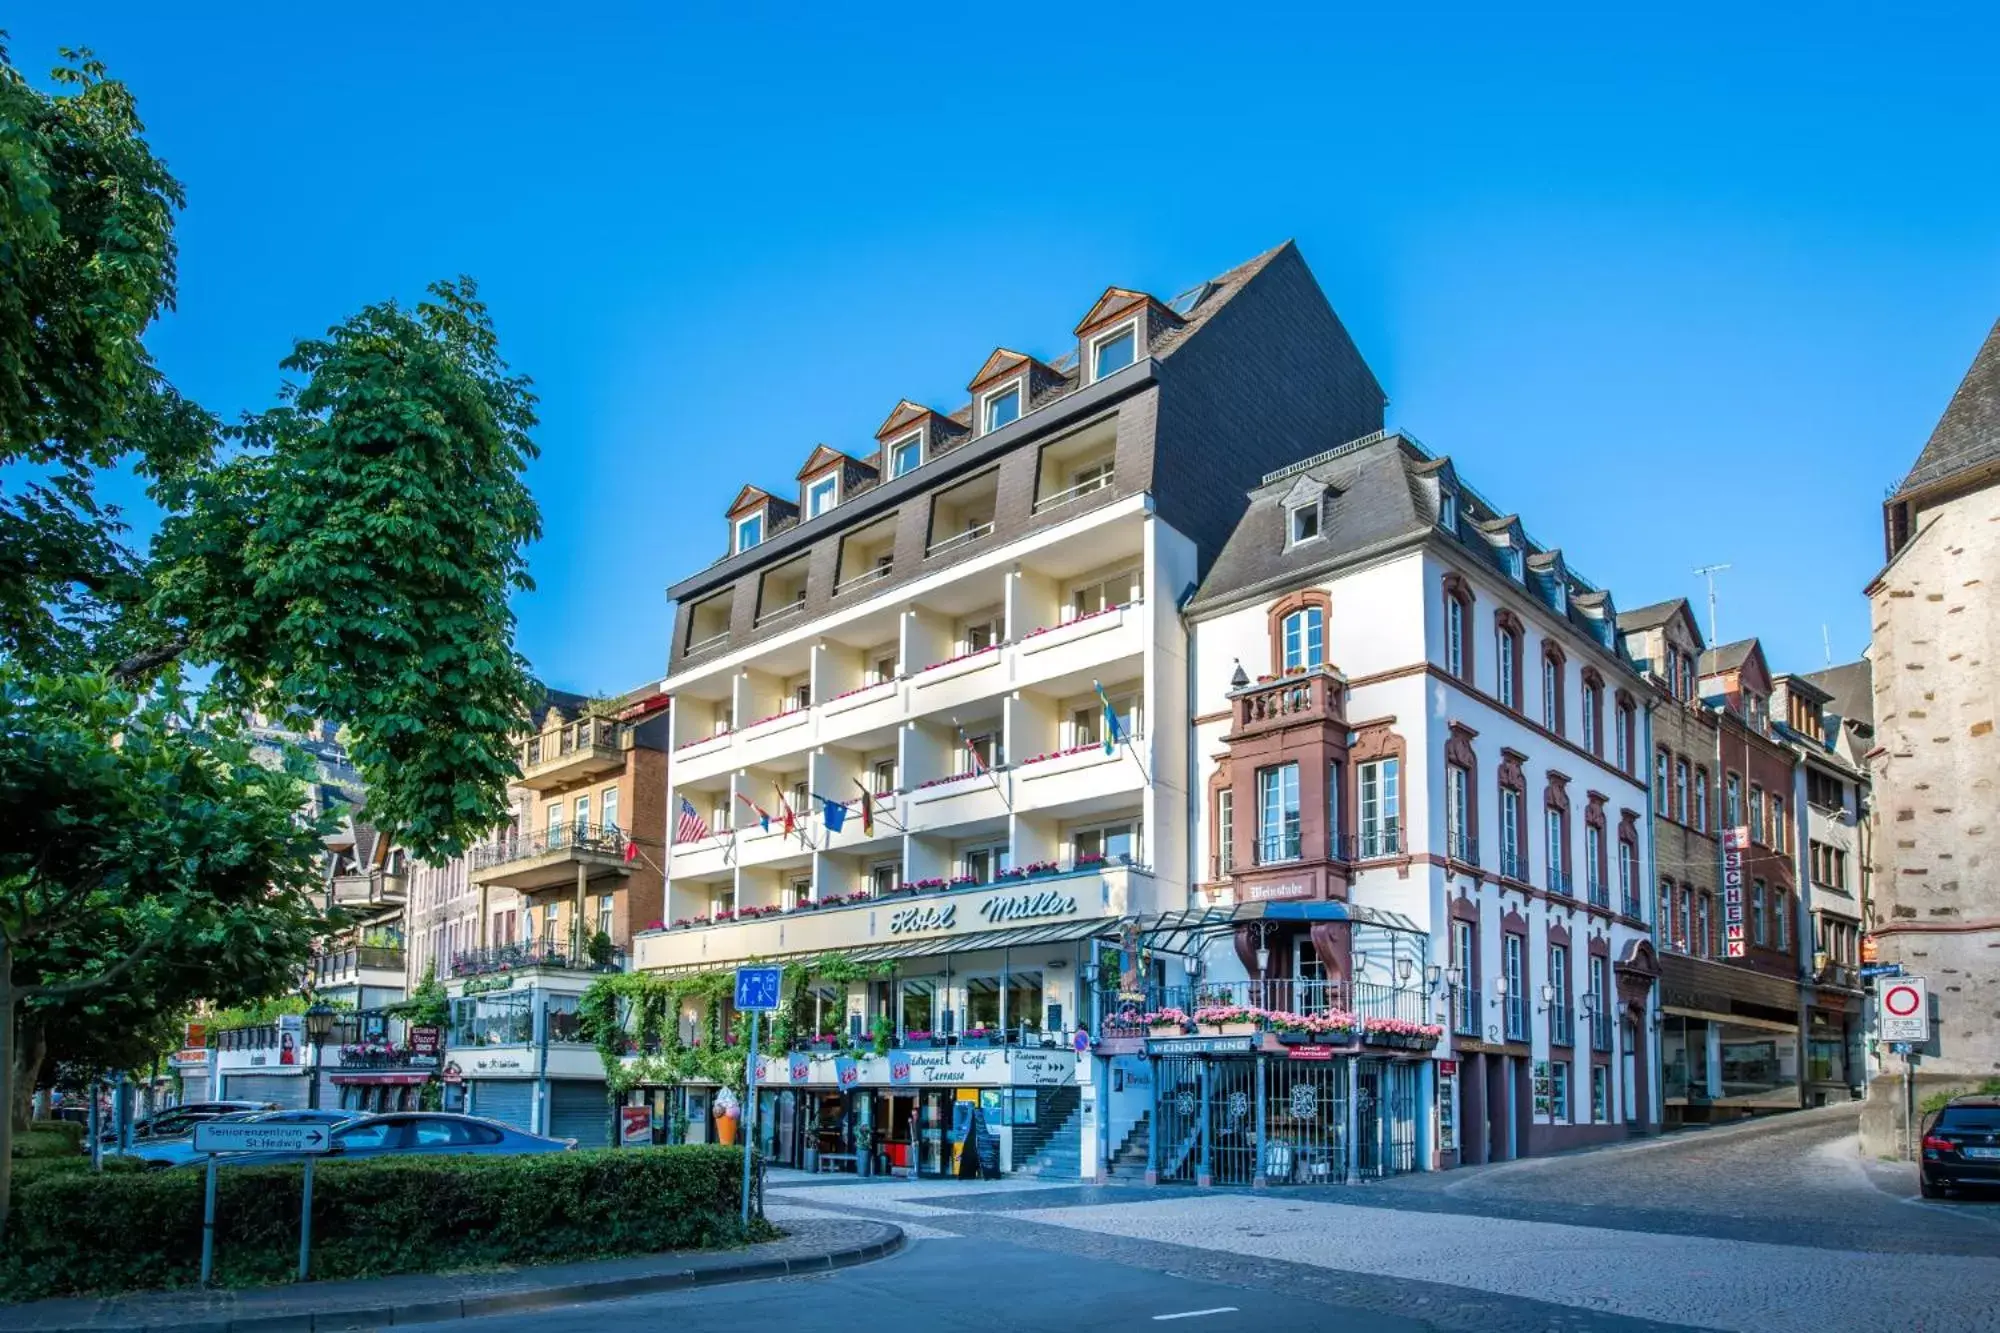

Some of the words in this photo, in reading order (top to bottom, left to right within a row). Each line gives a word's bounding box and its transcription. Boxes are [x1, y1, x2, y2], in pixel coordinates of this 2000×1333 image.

[889, 905, 956, 933] Hotel
[981, 891, 1077, 922] Müller
[1152, 1040, 1208, 1053] WEINGUT
[1213, 1039, 1249, 1051] RING
[961, 1051, 988, 1071] Café
[923, 1067, 965, 1082] Terrasse
[208, 1126, 302, 1137] Seniorenzentrum
[260, 1139, 302, 1149] Hedwig
